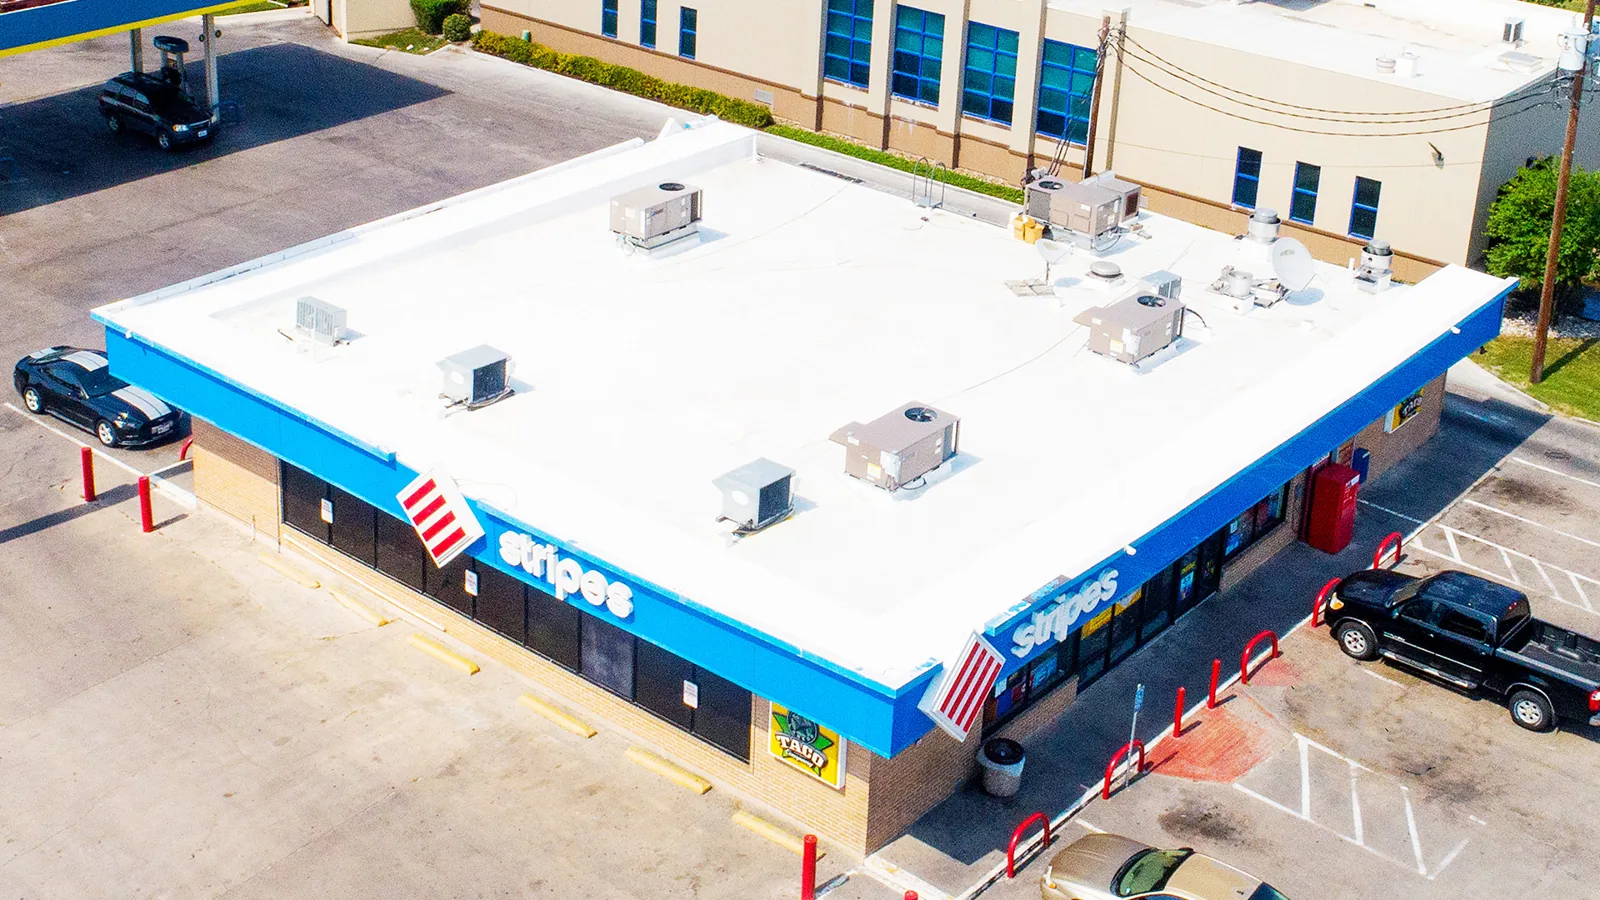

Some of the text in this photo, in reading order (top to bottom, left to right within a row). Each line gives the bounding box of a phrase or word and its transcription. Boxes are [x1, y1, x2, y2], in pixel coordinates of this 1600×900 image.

[498, 530, 634, 619] stripes
[1010, 567, 1119, 658] stripes
[776, 733, 825, 768] TACO
